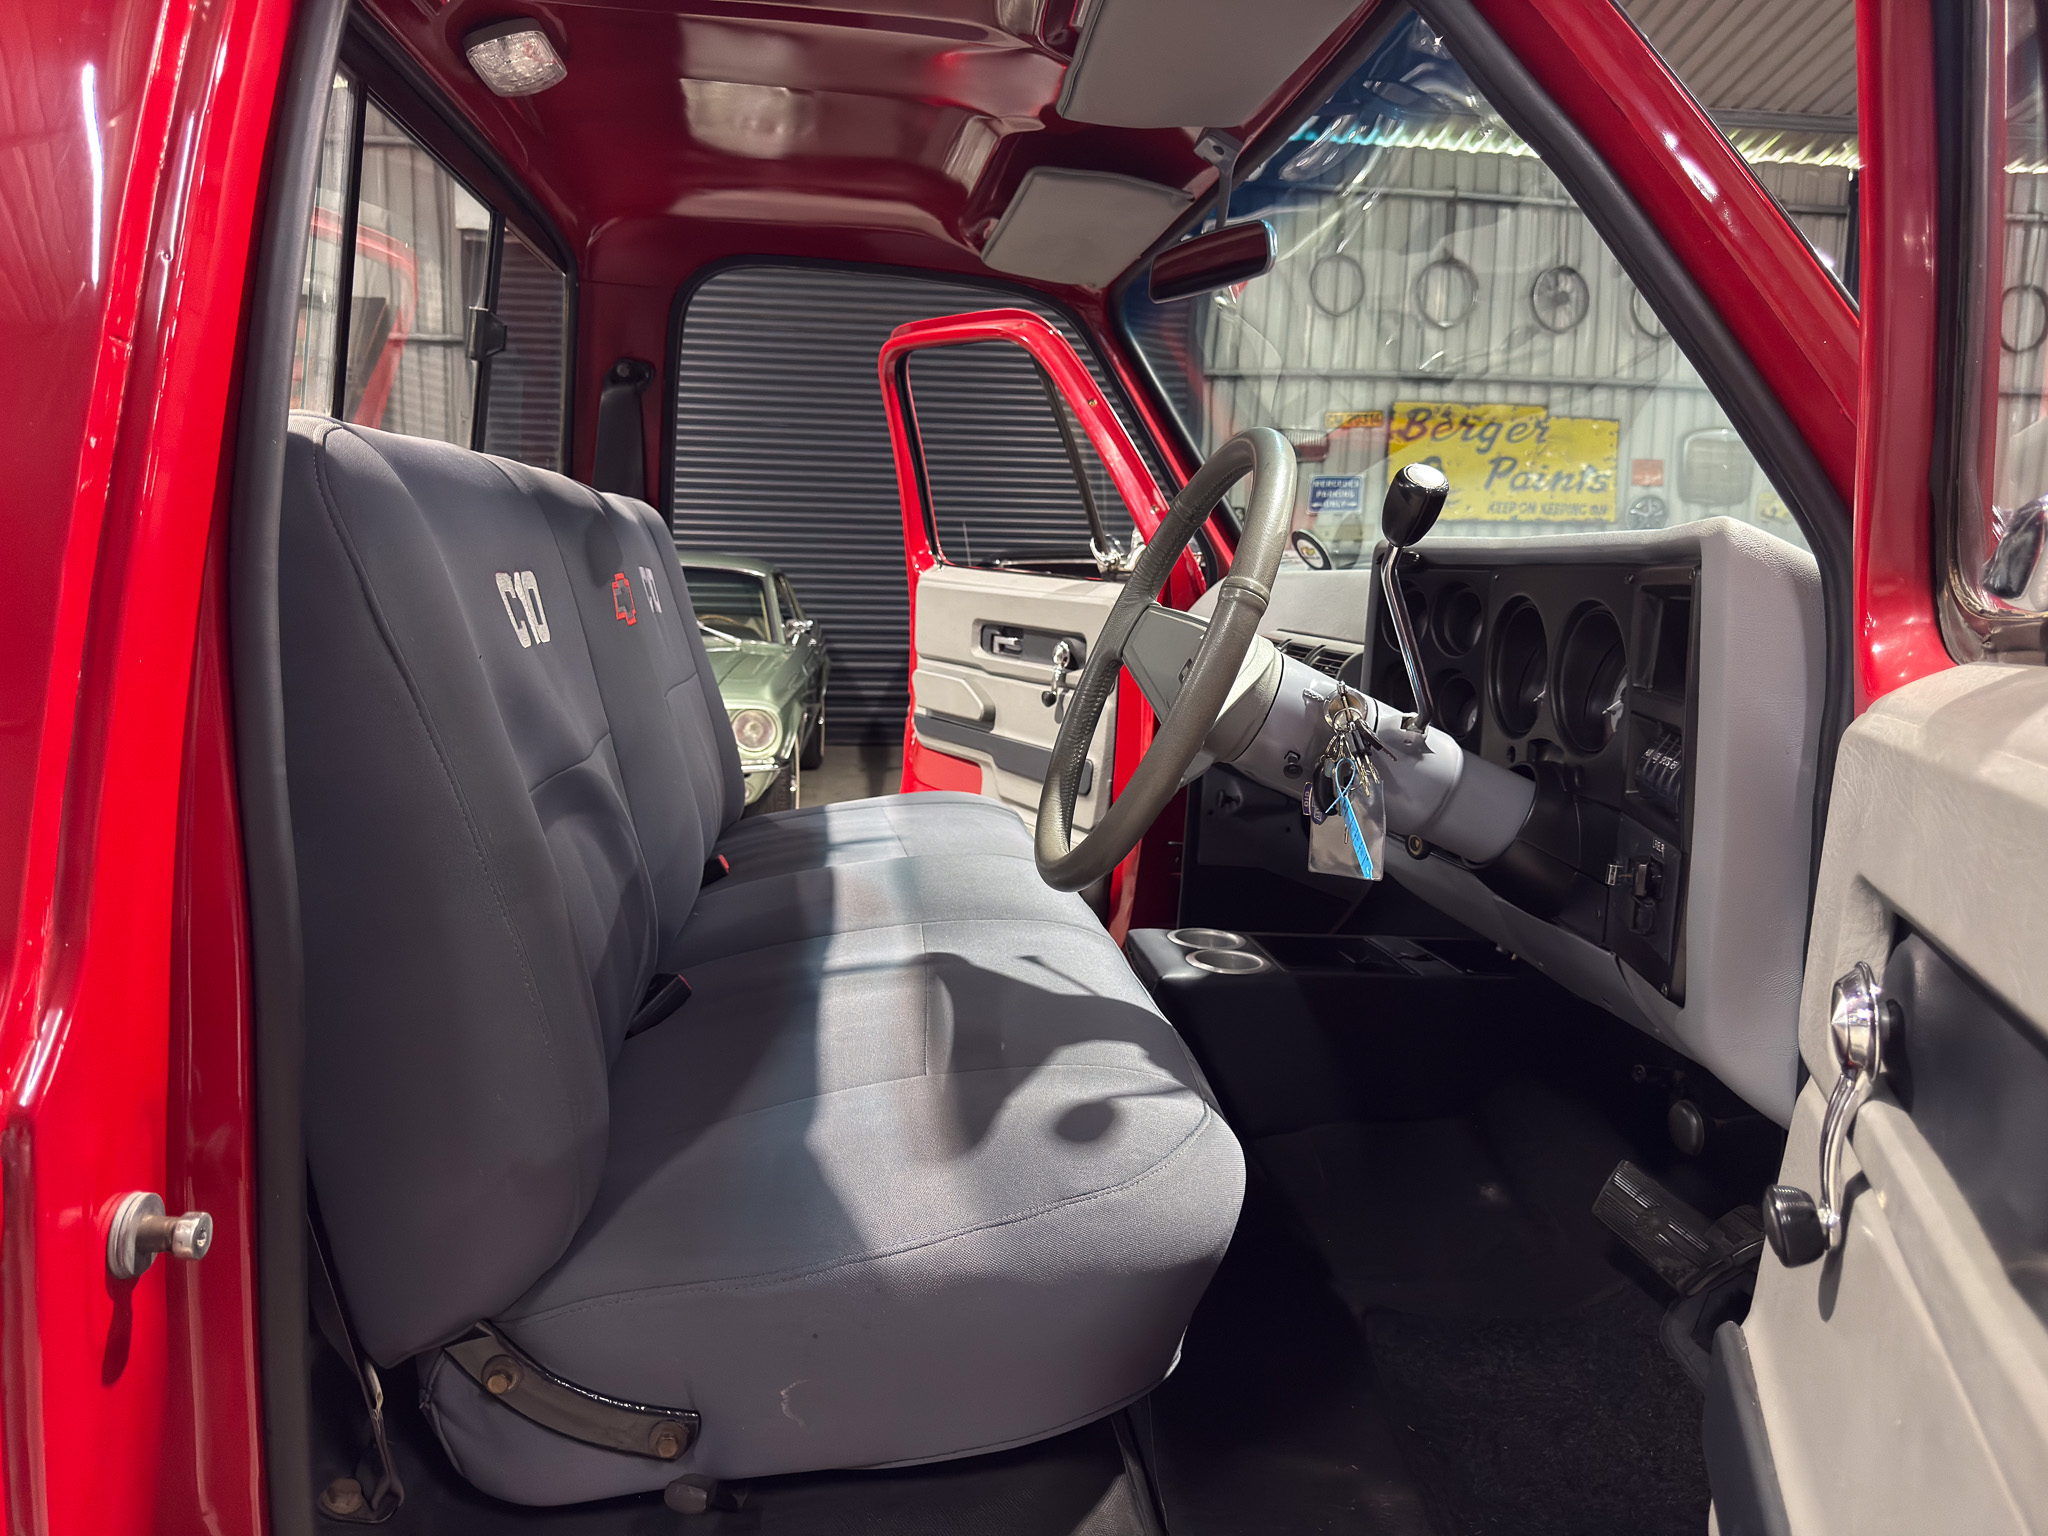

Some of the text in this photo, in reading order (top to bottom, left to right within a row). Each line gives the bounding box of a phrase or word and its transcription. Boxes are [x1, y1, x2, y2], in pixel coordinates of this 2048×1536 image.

[1397, 406, 1550, 453] Berger
[1484, 456, 1612, 494] Paints
[1322, 500, 1347, 508] ONLY
